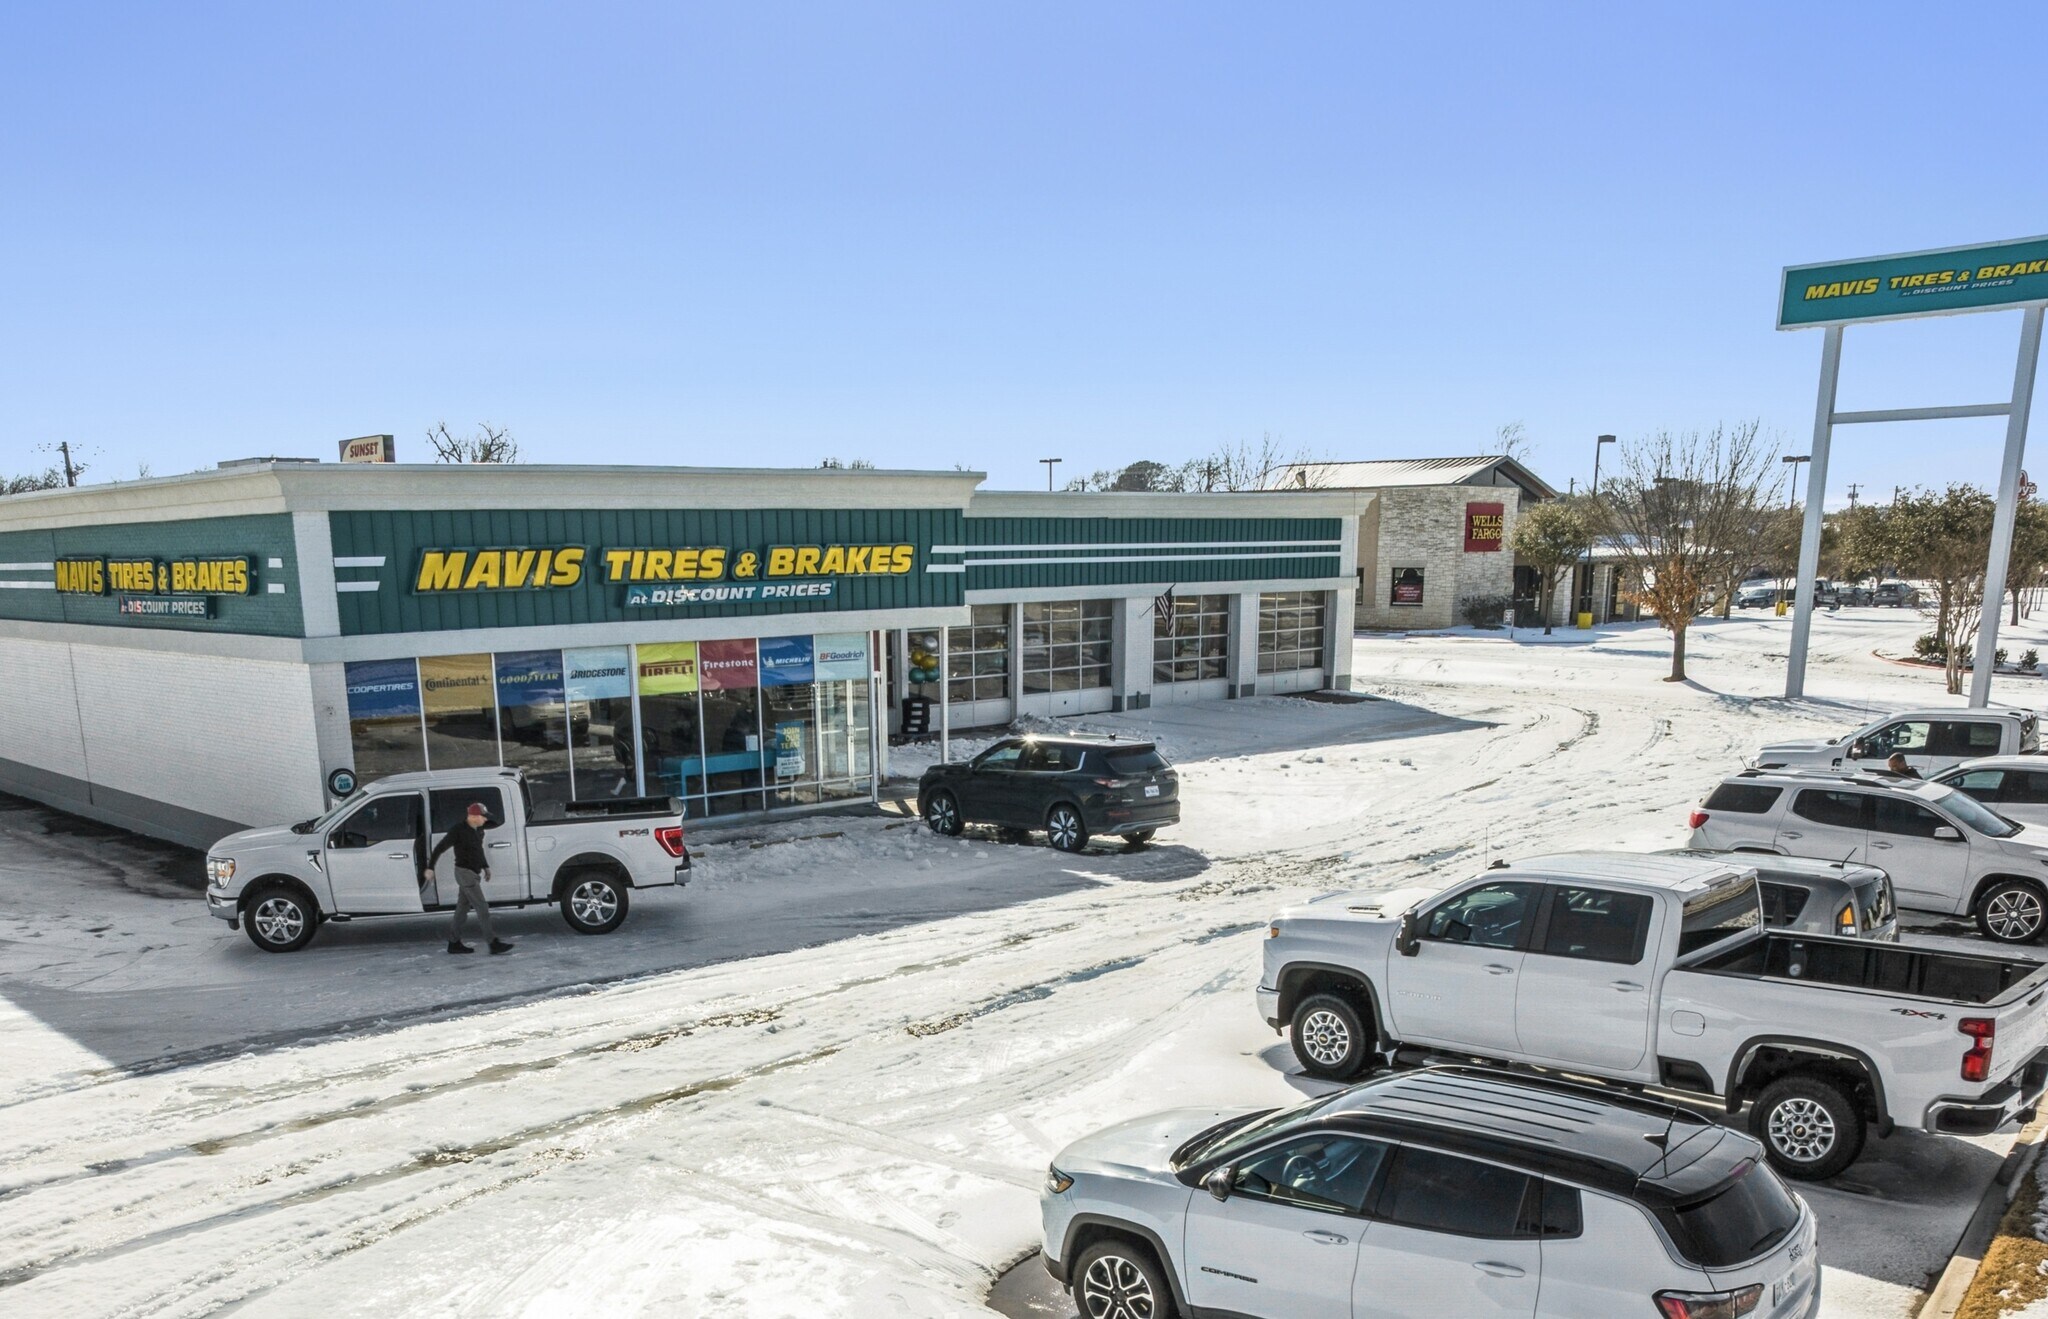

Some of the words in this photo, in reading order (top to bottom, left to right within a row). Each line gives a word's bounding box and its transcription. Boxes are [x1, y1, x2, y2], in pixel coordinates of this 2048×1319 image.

[1805, 279, 1879, 300] MAVIS
[1890, 271, 1954, 288] TIRES
[1957, 271, 1970, 281] &
[1913, 284, 1968, 295] DISCOUNT
[1971, 279, 2015, 289] PRICES
[350, 442, 379, 458] SUNSET
[1472, 515, 1503, 527] WELLS
[1472, 528, 1502, 540] FARGO
[417, 548, 585, 590] MAVIS
[606, 548, 726, 580] TIRES
[735, 552, 757, 577] &
[768, 545, 914, 576] BRAKES
[56, 560, 103, 593] MAVIS
[108, 562, 154, 592] TIRES
[158, 566, 168, 591] &
[172, 560, 247, 593] BRAKES
[630, 595, 648, 604] At
[651, 586, 756, 603] DISCOUNT
[761, 583, 832, 598] PRICES
[128, 600, 169, 614] DISCOUNT
[171, 601, 205, 615] PRICES
[775, 656, 811, 665] MICHELIN
[820, 651, 864, 660] BFGoodrich
[640, 659, 694, 677] PIRELLI
[703, 659, 754, 670] Firestone
[500, 671, 559, 684] GOODYEAR
[570, 667, 626, 679] BRIDGESTONE
[425, 676, 480, 691] Continental
[1200, 1266, 1258, 1284] COMPASS
